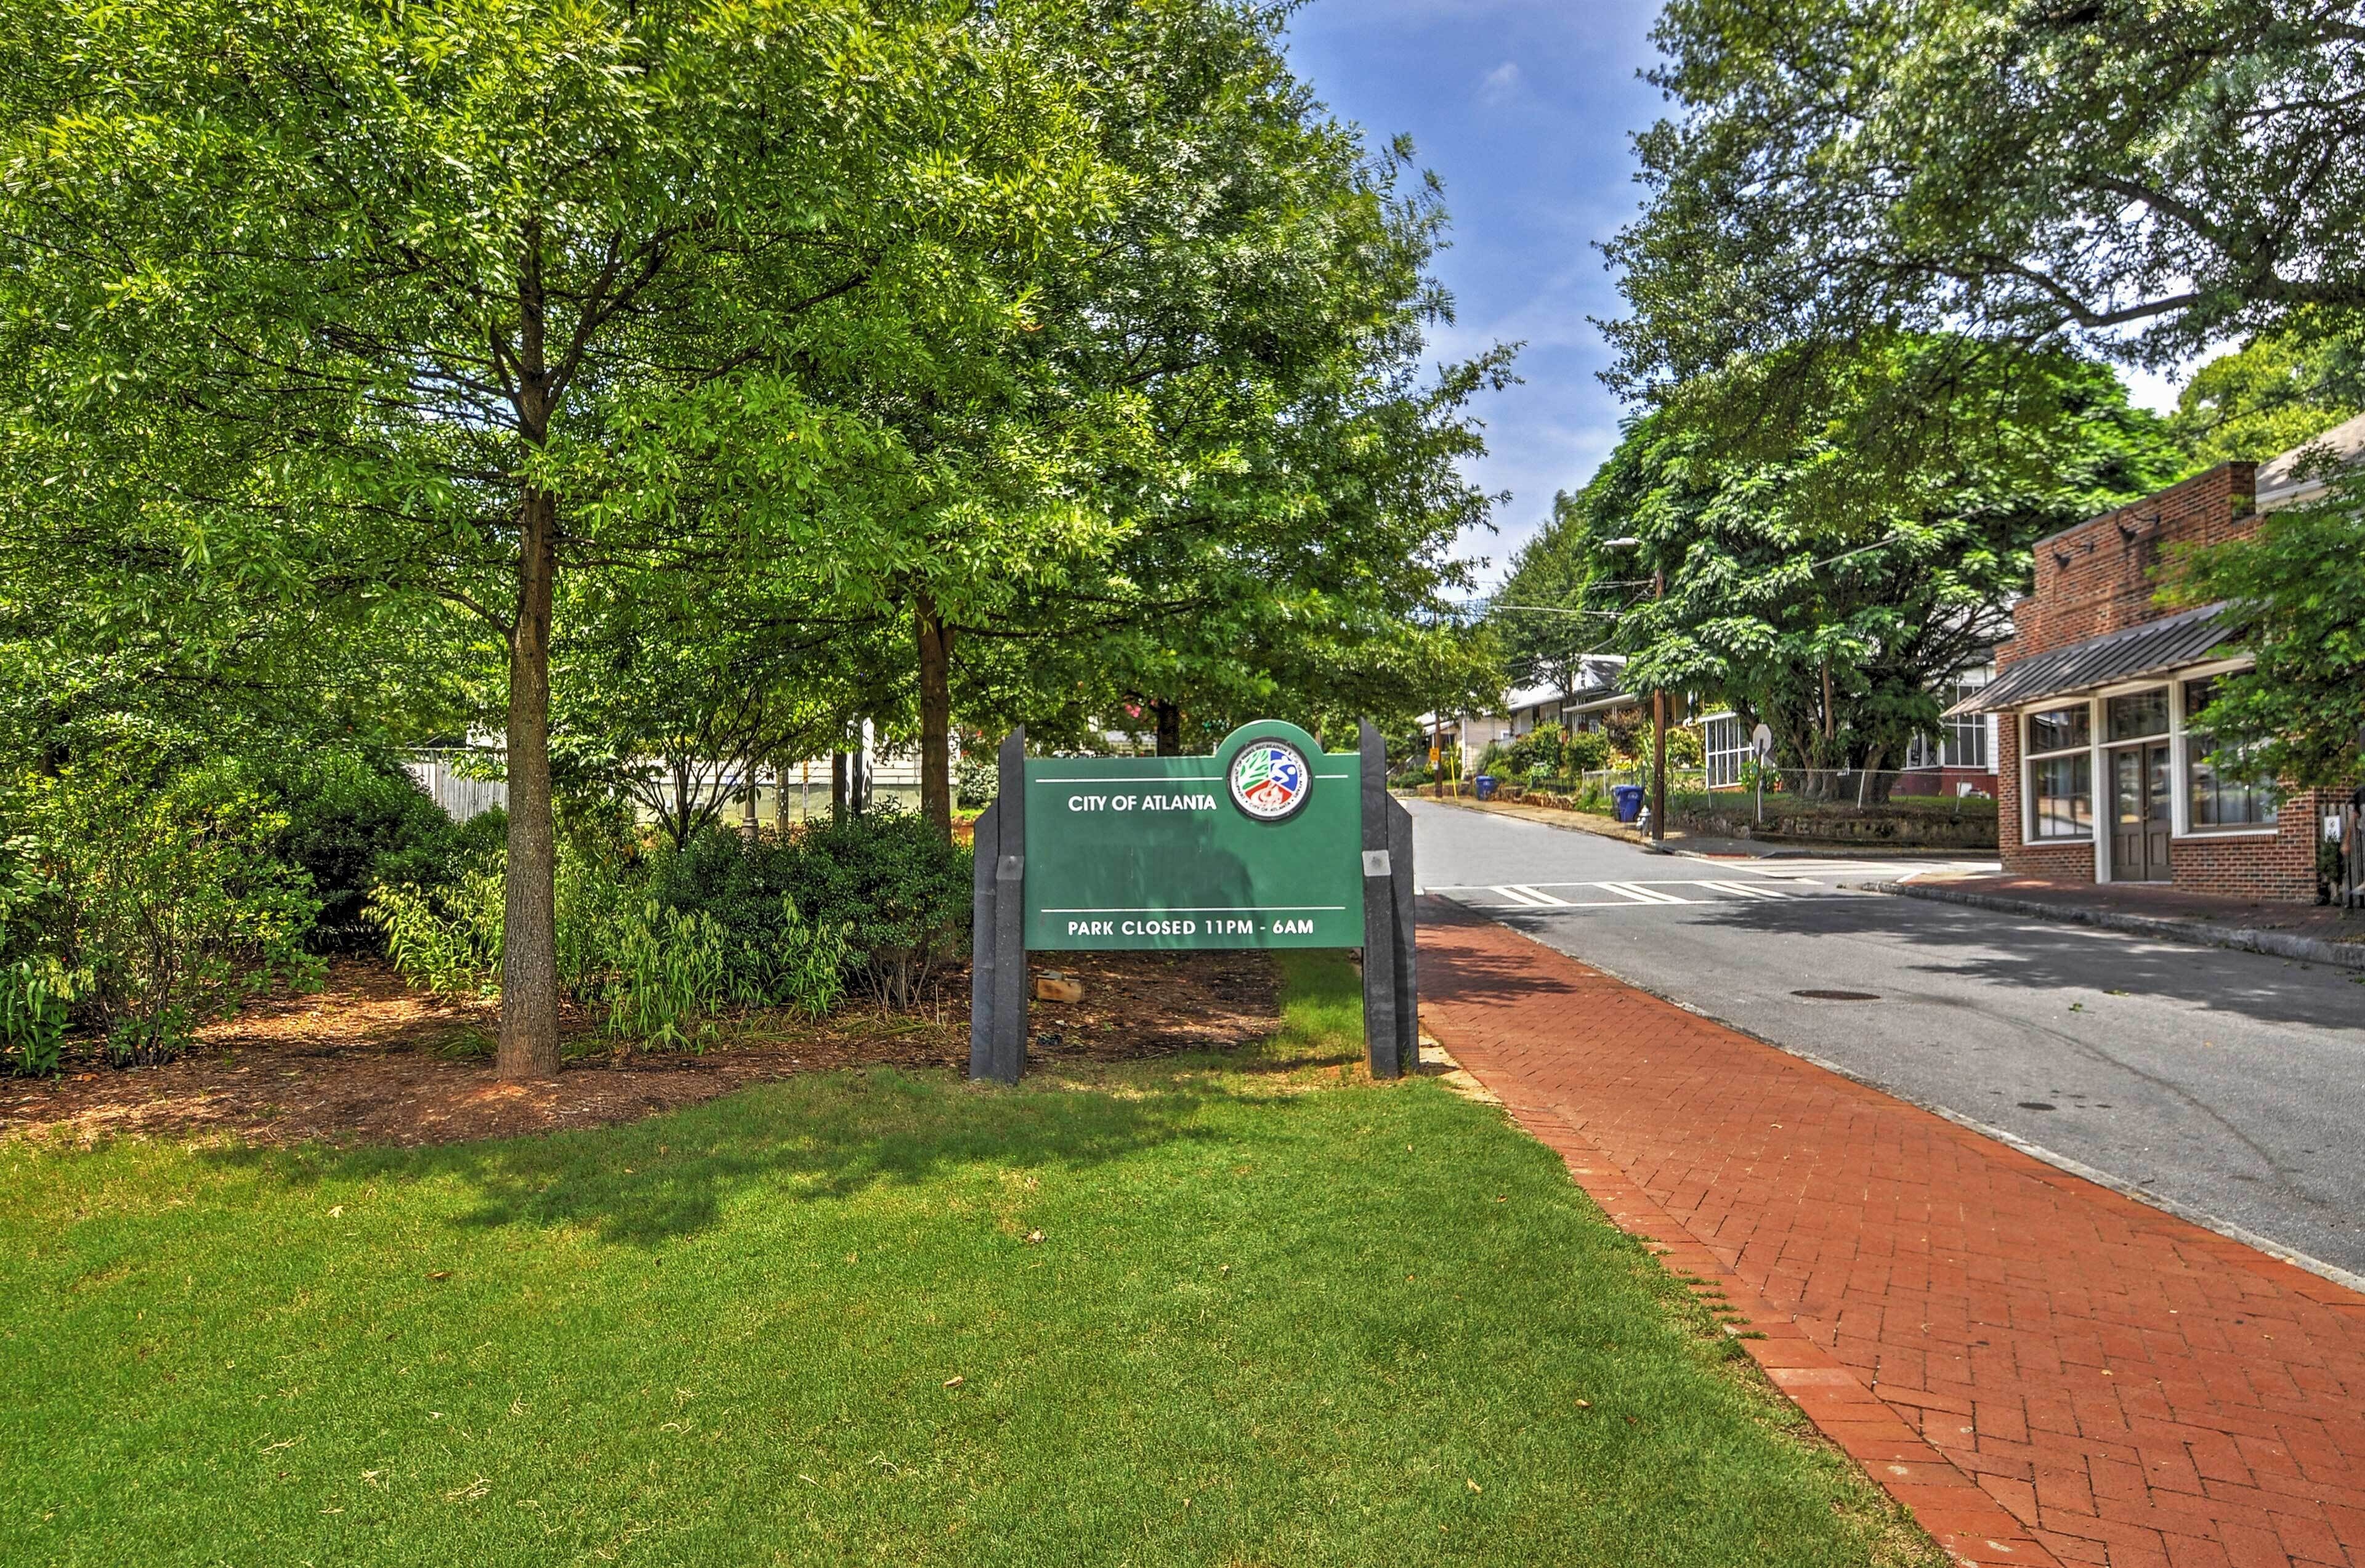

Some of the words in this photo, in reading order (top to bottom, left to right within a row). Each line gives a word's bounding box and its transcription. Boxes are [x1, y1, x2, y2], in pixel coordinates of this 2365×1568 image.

[1256, 744, 1288, 753] RECREATION
[1068, 795, 1107, 812] CITY
[1111, 794, 1137, 811] OF
[1141, 794, 1217, 810] ATLANTA
[1270, 802, 1290, 812] ATLANTA
[1068, 921, 1114, 936] PARK
[1121, 921, 1196, 935] CLOSED
[1205, 919, 1253, 934] 11PM
[1272, 919, 1314, 934] 6AM
